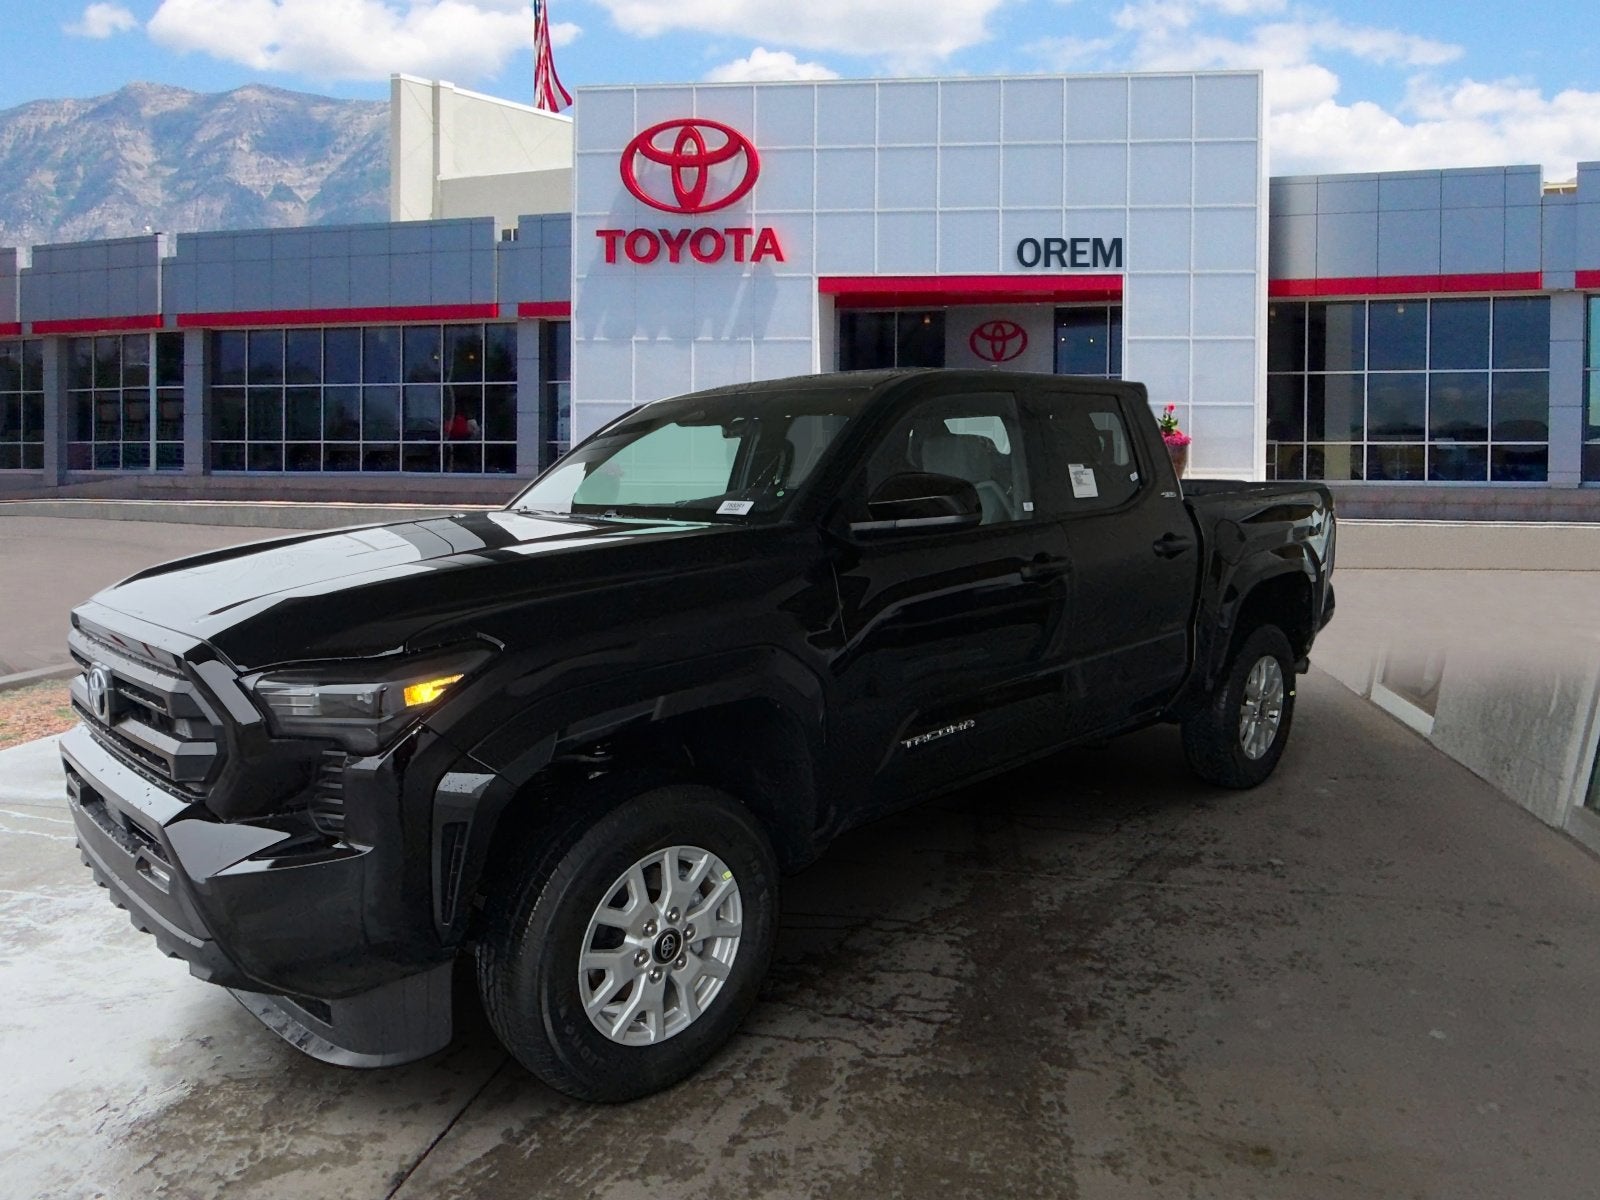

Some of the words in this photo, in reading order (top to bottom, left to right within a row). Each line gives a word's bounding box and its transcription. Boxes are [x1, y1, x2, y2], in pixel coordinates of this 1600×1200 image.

[596, 227, 784, 264] TOYOTA
[1017, 238, 1122, 267] OREM
[900, 720, 976, 749] TACOMA
